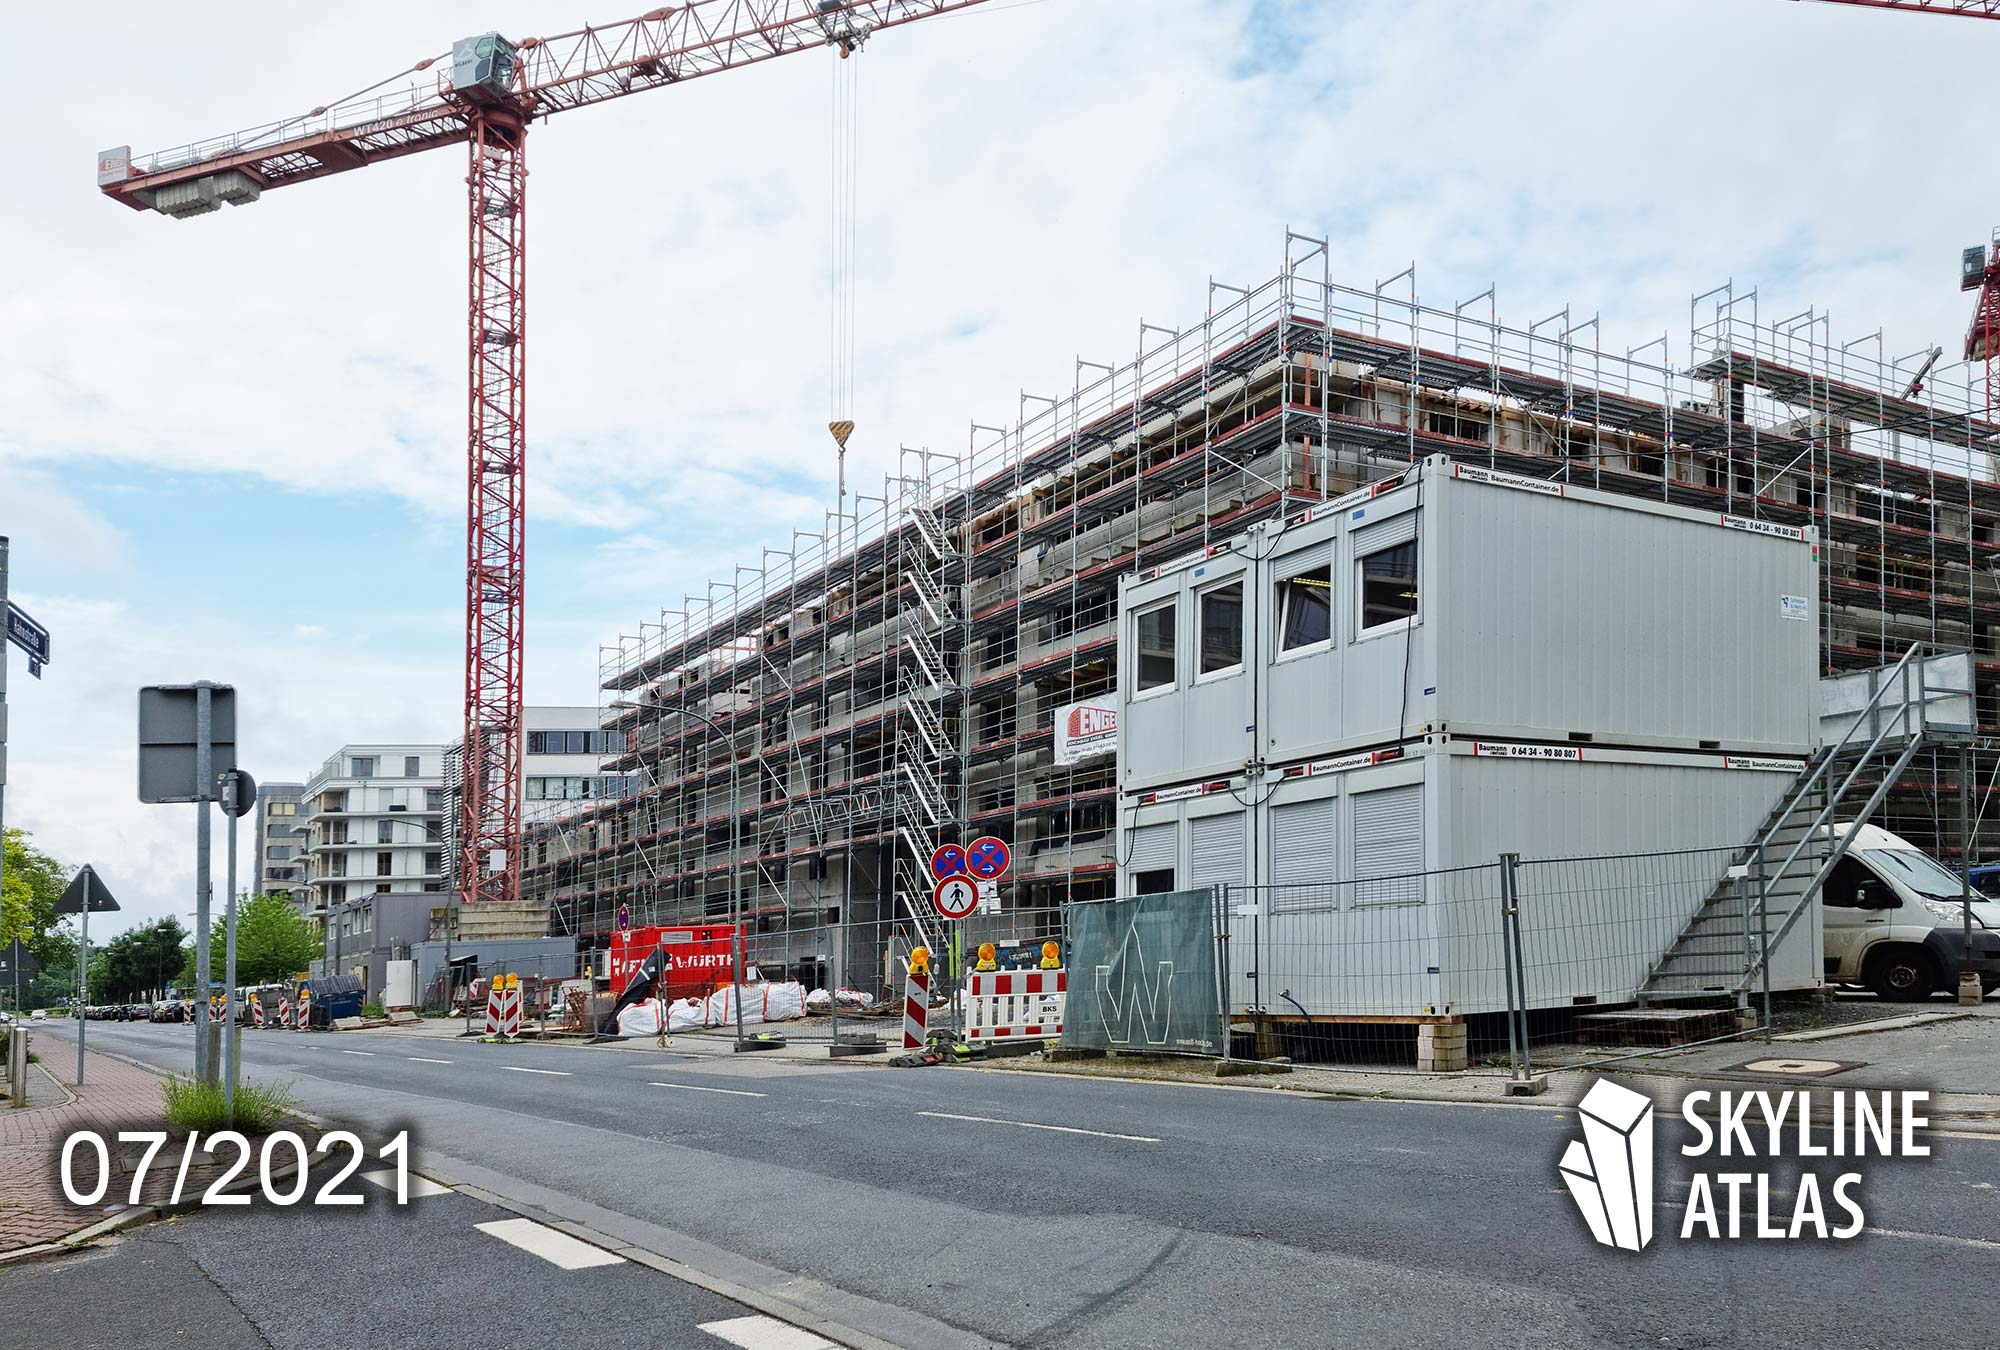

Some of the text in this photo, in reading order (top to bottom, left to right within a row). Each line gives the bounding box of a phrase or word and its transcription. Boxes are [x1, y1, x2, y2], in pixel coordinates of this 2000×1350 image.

[354, 120, 393, 137] WT420
[1459, 466, 1559, 493] Baumann BaumannContainer.de
[1312, 491, 1370, 516] BaumannContainer.de
[1725, 516, 1746, 526] Baumann
[1763, 524, 1769, 532] 34
[1080, 709, 1116, 735] ENGE
[1479, 744, 1507, 753] Baumann
[1511, 747, 1516, 755] 0
[1518, 747, 1526, 756] 64
[1528, 748, 1537, 756] 34
[1544, 749, 1552, 757] 90
[1554, 749, 1562, 757] 80
[1564, 750, 1577, 758] 807
[1312, 756, 1371, 773] BaumannContainer.de
[1728, 757, 1750, 765] Baumann
[1752, 761, 1804, 770] BaumannContainer.de
[1157, 787, 1202, 800] BaumannContainer.de
[1042, 1005, 1057, 1013] BKS
